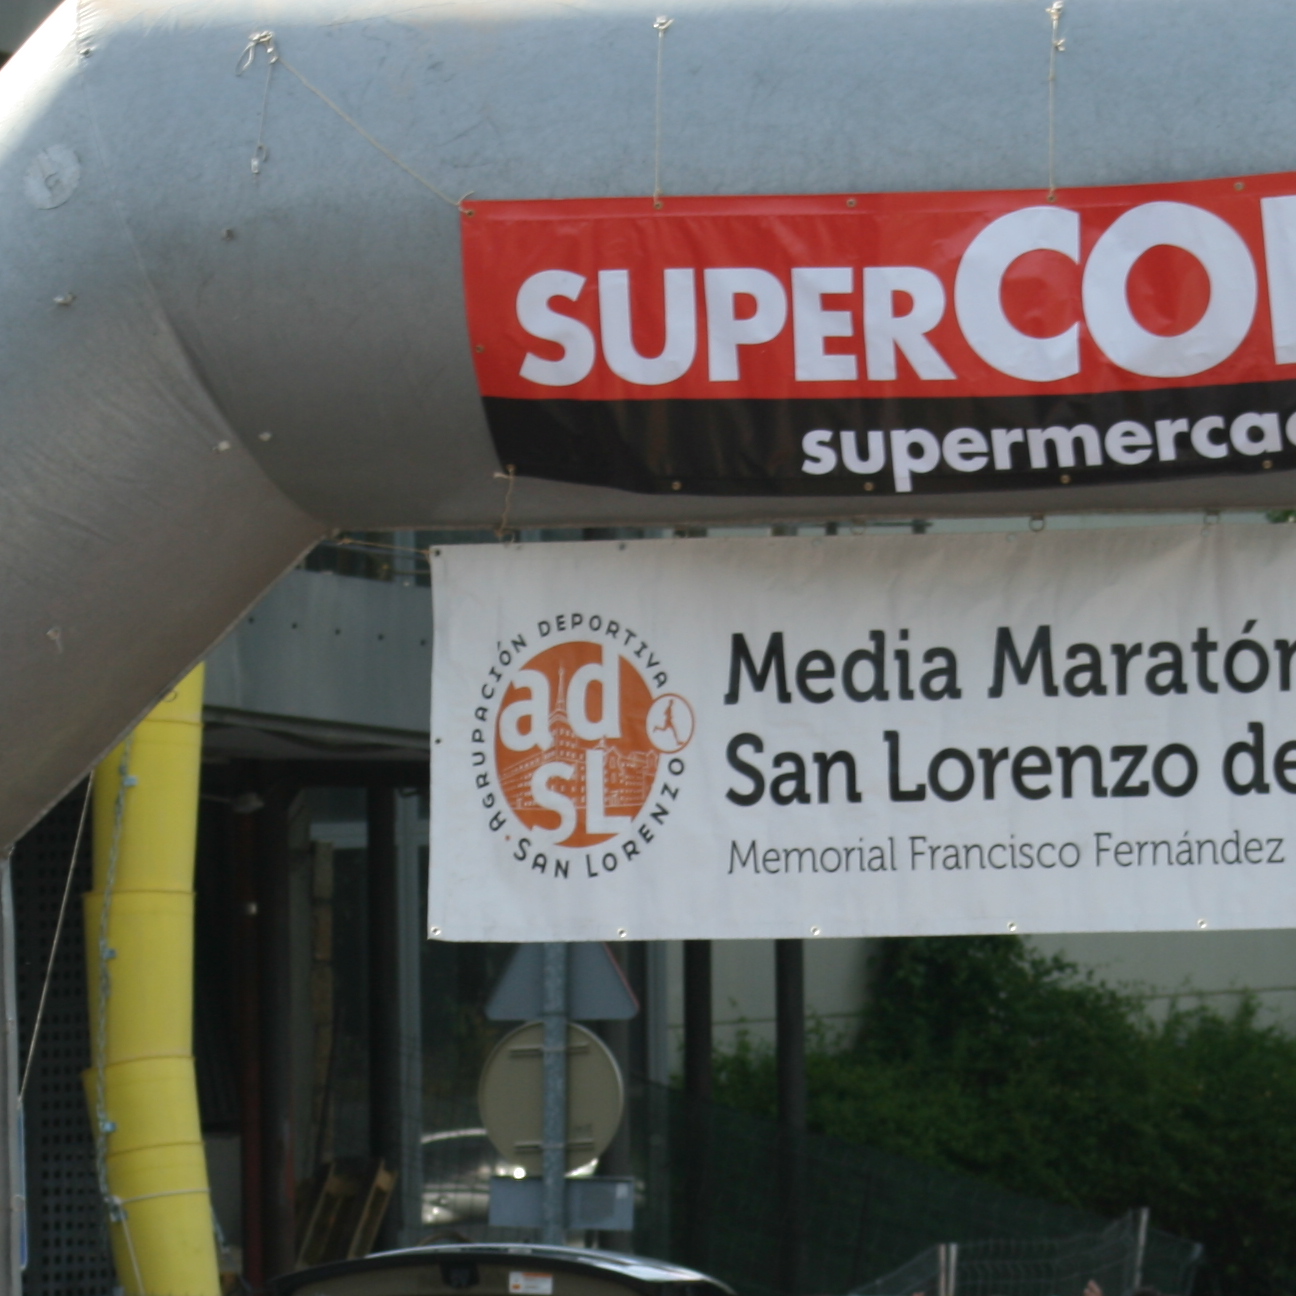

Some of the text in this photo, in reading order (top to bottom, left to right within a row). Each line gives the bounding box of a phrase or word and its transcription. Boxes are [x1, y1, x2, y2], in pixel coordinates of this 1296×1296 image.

[723, 628, 961, 706] Media
[471, 612, 668, 832] AGRUPACIÓN DEPORTIVA
[724, 732, 862, 806] San
[884, 728, 1199, 804] Lorenzo
[513, 757, 685, 880] SAN LORENZO
[727, 836, 896, 875] Memorial
[910, 835, 1082, 872] Francisco
[1093, 829, 1285, 869] Fernández
